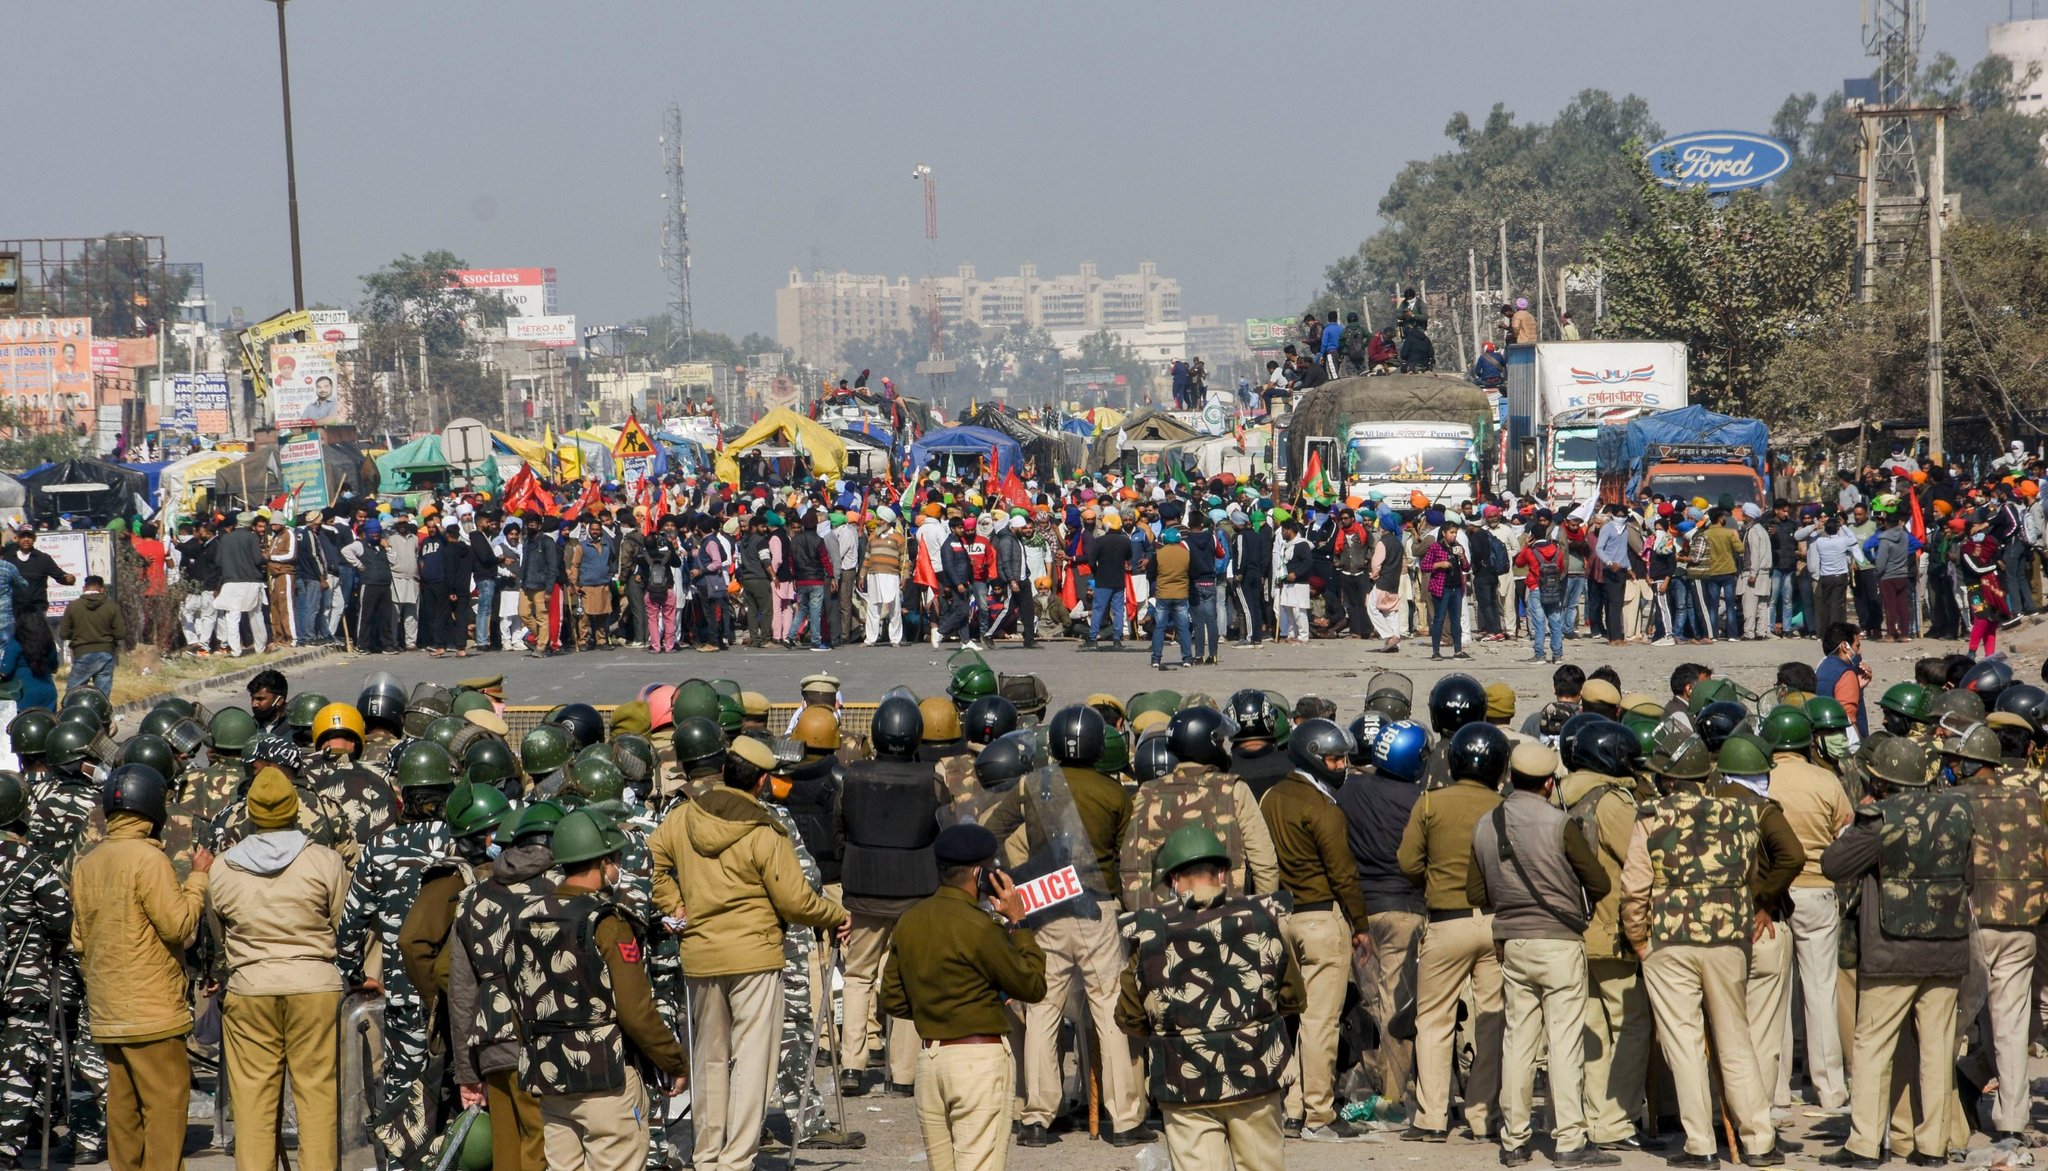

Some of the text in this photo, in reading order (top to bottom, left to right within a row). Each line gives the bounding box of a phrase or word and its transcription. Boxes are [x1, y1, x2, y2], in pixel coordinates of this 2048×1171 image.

[1675, 146, 1754, 178] Ford
[462, 272, 519, 283] ssociates
[1602, 369, 1625, 380] JML
[175, 394, 227, 402] ASSCIATES
[1568, 396, 1584, 407] K
[1644, 393, 1660, 405] S
[966, 544, 982, 553] ILA
[1016, 868, 1080, 913] OLICE
